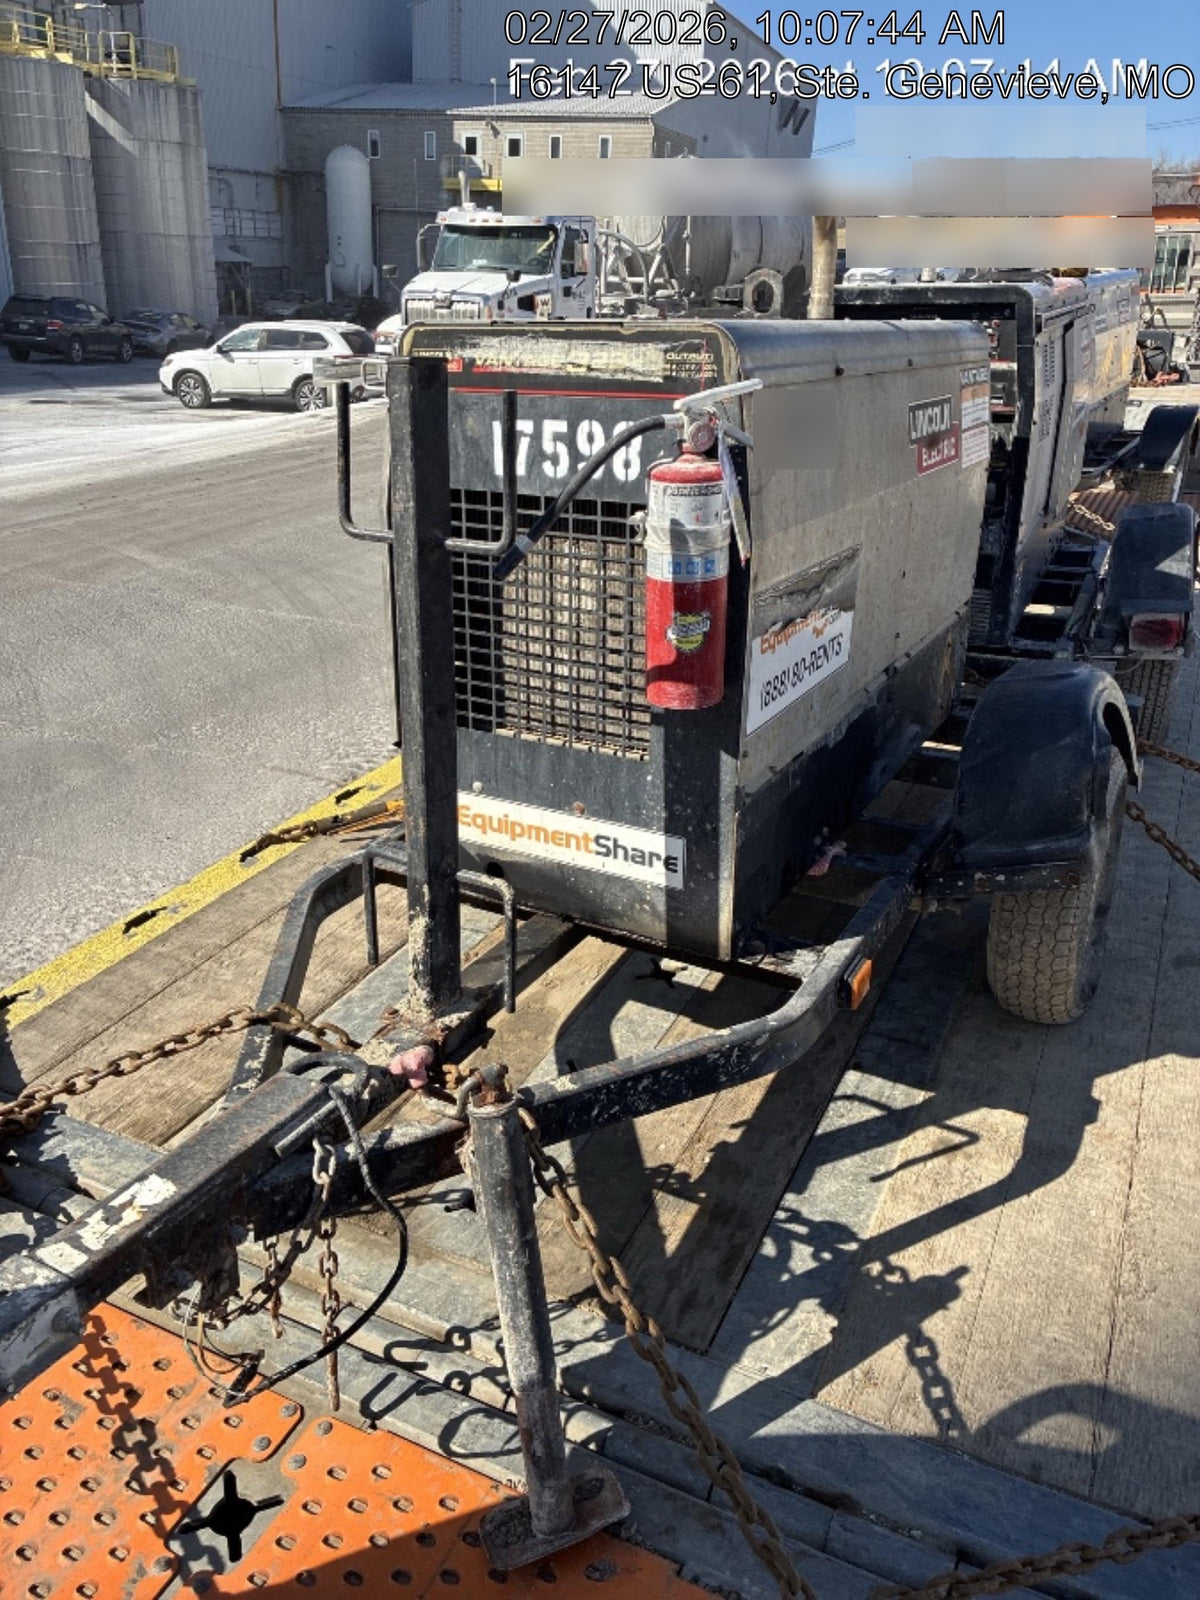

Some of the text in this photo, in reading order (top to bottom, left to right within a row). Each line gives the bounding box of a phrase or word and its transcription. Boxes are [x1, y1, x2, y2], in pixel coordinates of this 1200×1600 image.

[491, 418, 643, 481] 17598
[909, 402, 950, 440] LINCOLN
[457, 804, 679, 874] EquipmentShare
